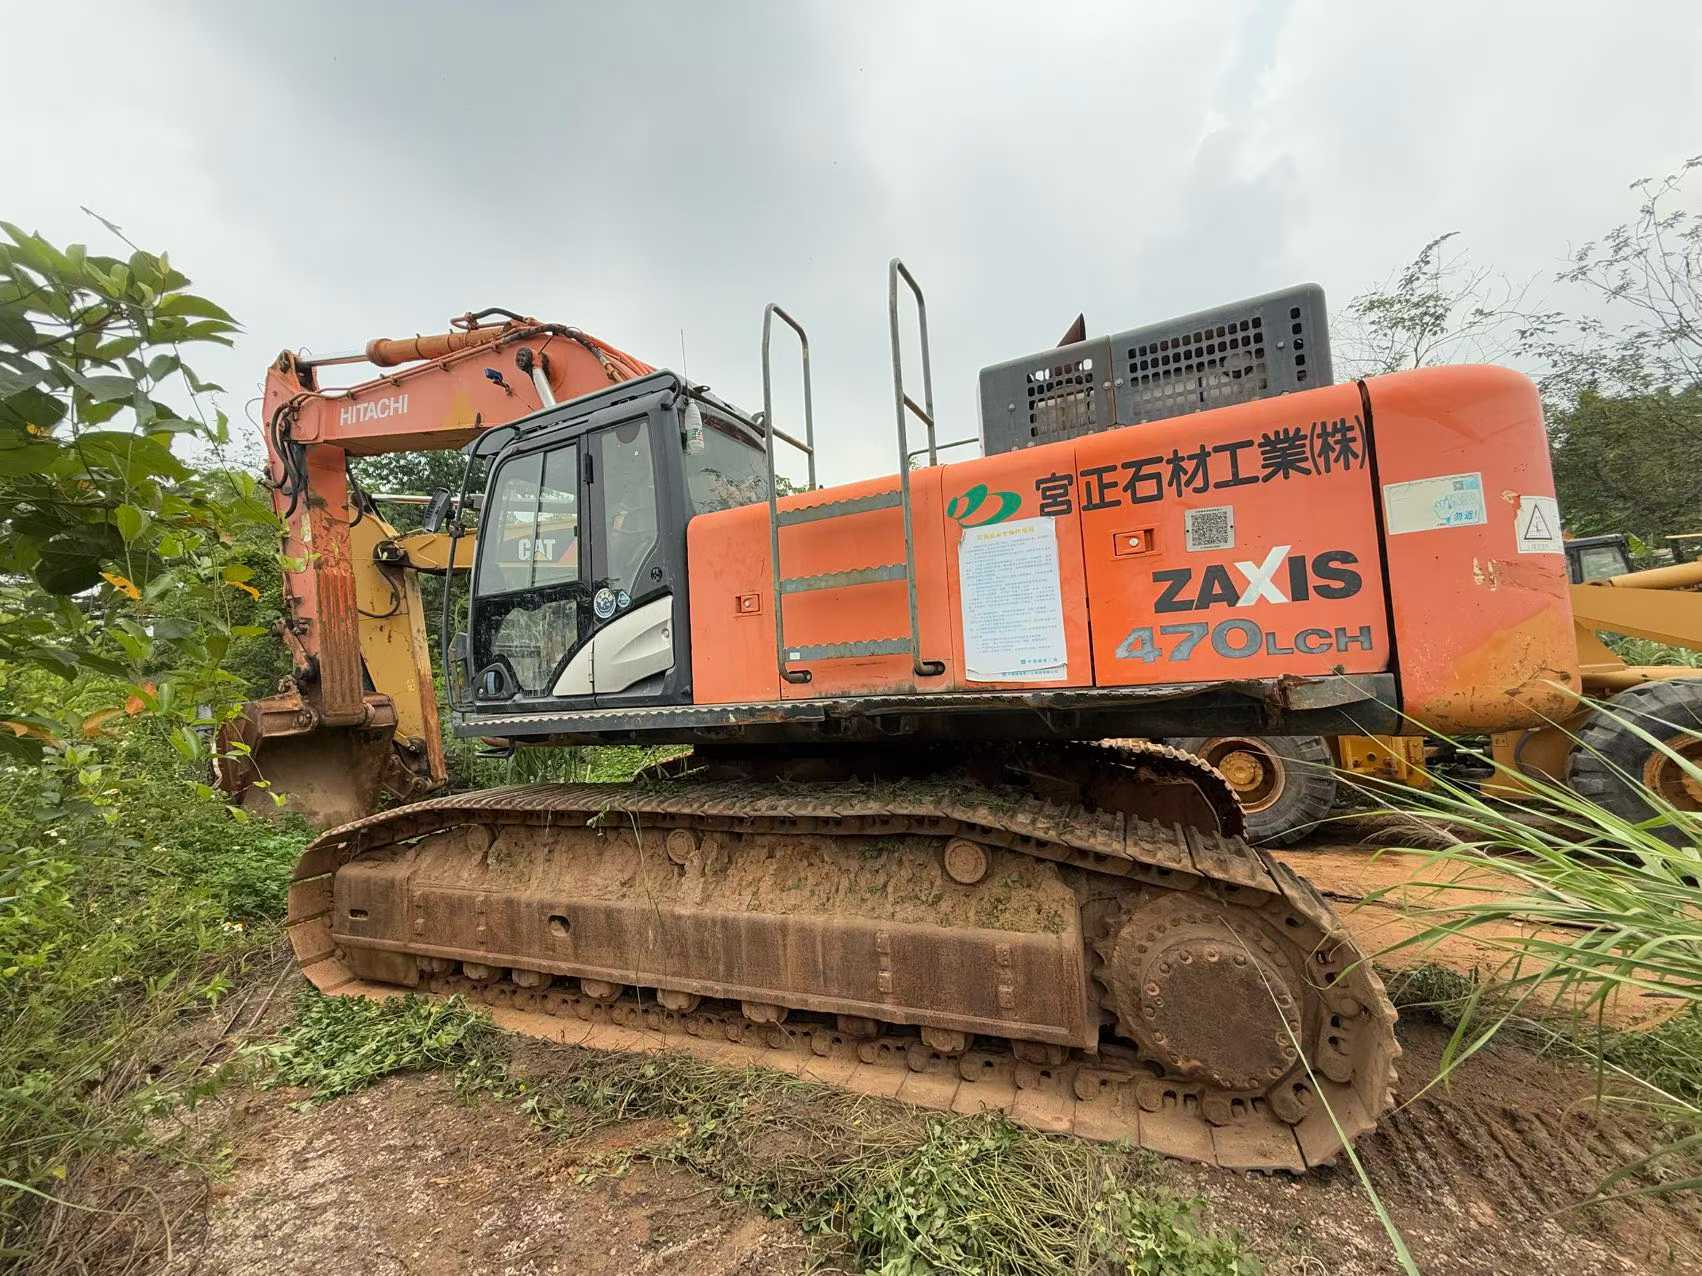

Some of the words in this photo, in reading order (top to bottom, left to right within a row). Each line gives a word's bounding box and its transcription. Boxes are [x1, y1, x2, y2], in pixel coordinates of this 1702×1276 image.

[340, 394, 408, 426] HITACHI
[518, 538, 556, 561] CAT
[1152, 545, 1362, 614] ZAXIS
